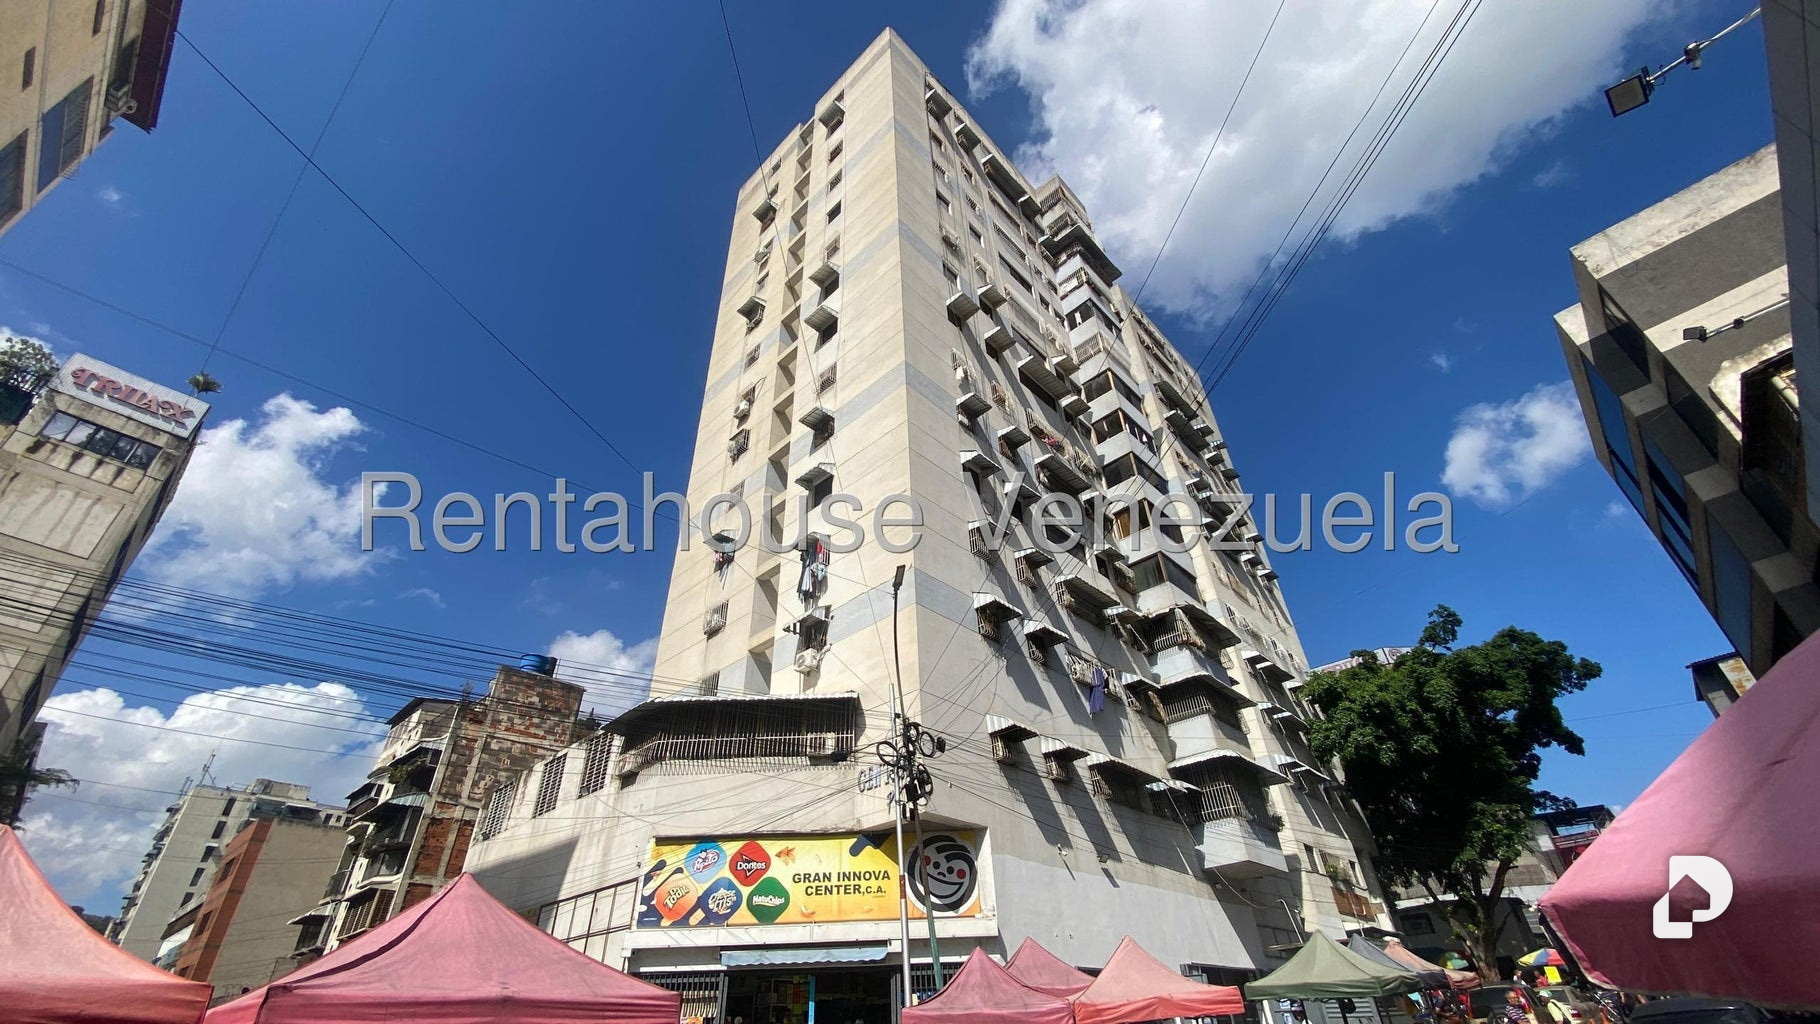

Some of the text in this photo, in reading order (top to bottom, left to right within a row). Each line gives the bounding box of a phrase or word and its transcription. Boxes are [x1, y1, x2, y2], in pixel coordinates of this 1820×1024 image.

[736, 861, 767, 871] Doritos
[792, 870, 891, 884] GRAN INNOVA
